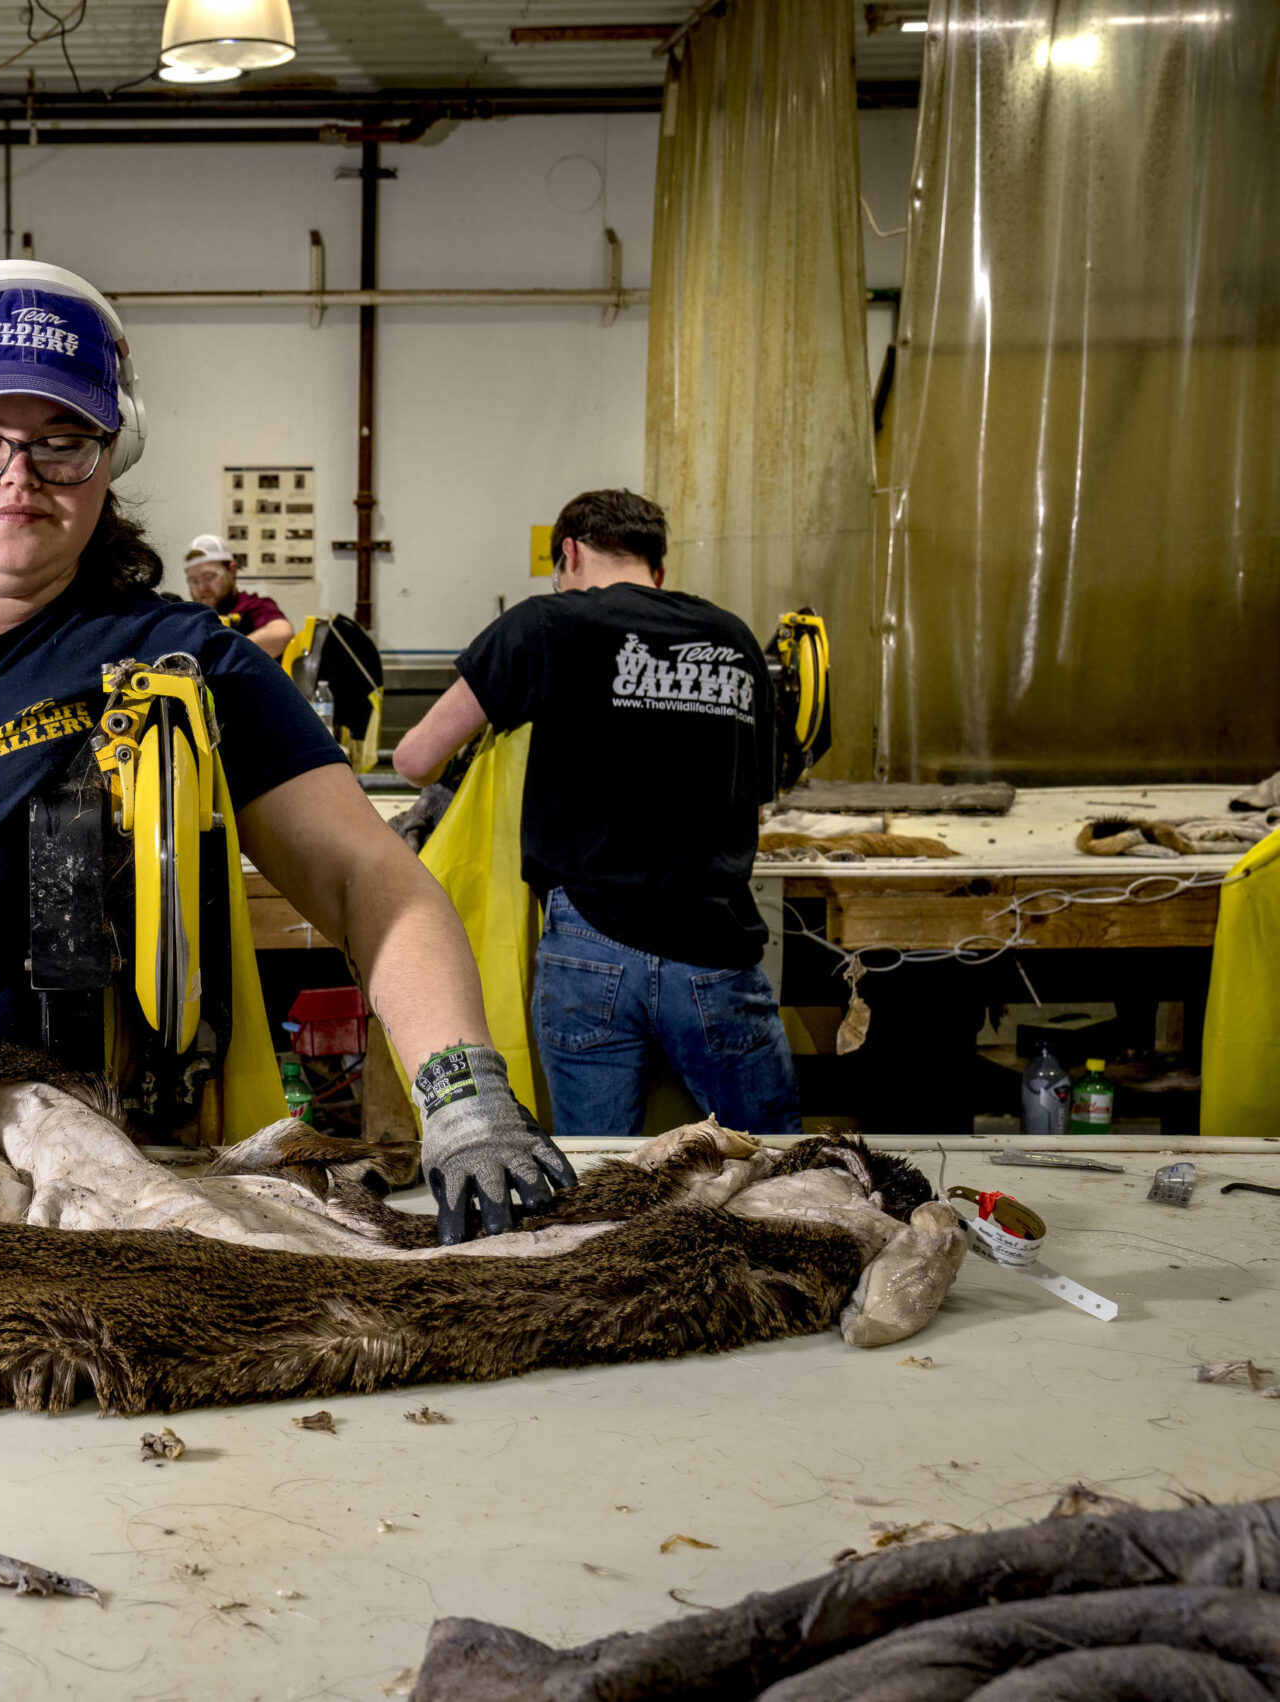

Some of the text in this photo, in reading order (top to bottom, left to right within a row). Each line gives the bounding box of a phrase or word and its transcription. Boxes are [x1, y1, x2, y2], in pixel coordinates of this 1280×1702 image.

[11, 307, 68, 325] Team
[669, 641, 744, 663] Team
[616, 654, 755, 687] WILDLIFE
[612, 674, 754, 712] GALLERY
